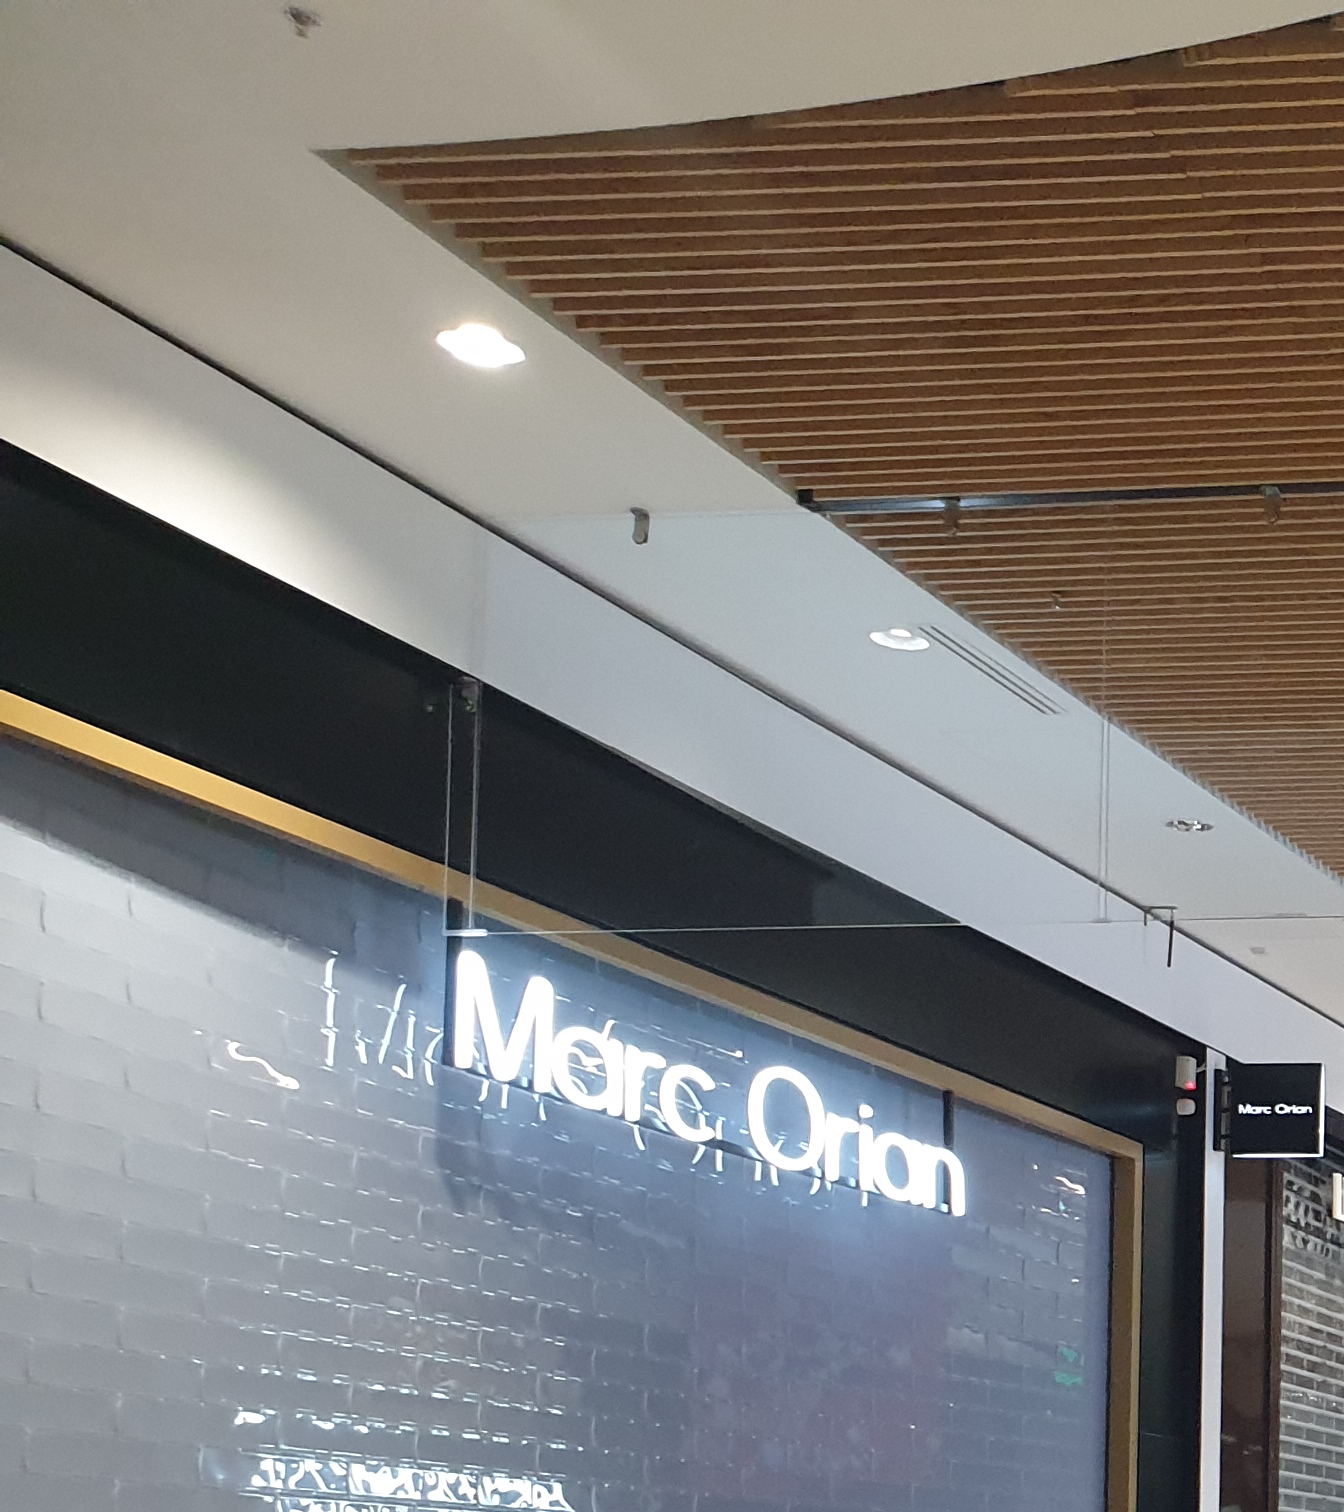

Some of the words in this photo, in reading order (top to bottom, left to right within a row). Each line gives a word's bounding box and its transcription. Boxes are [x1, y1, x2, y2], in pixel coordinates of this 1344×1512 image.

[454, 949, 720, 1144] Marc
[747, 1066, 966, 1218] Orian
[1238, 1103, 1272, 1115] Marc
[1275, 1103, 1313, 1115] Orian
